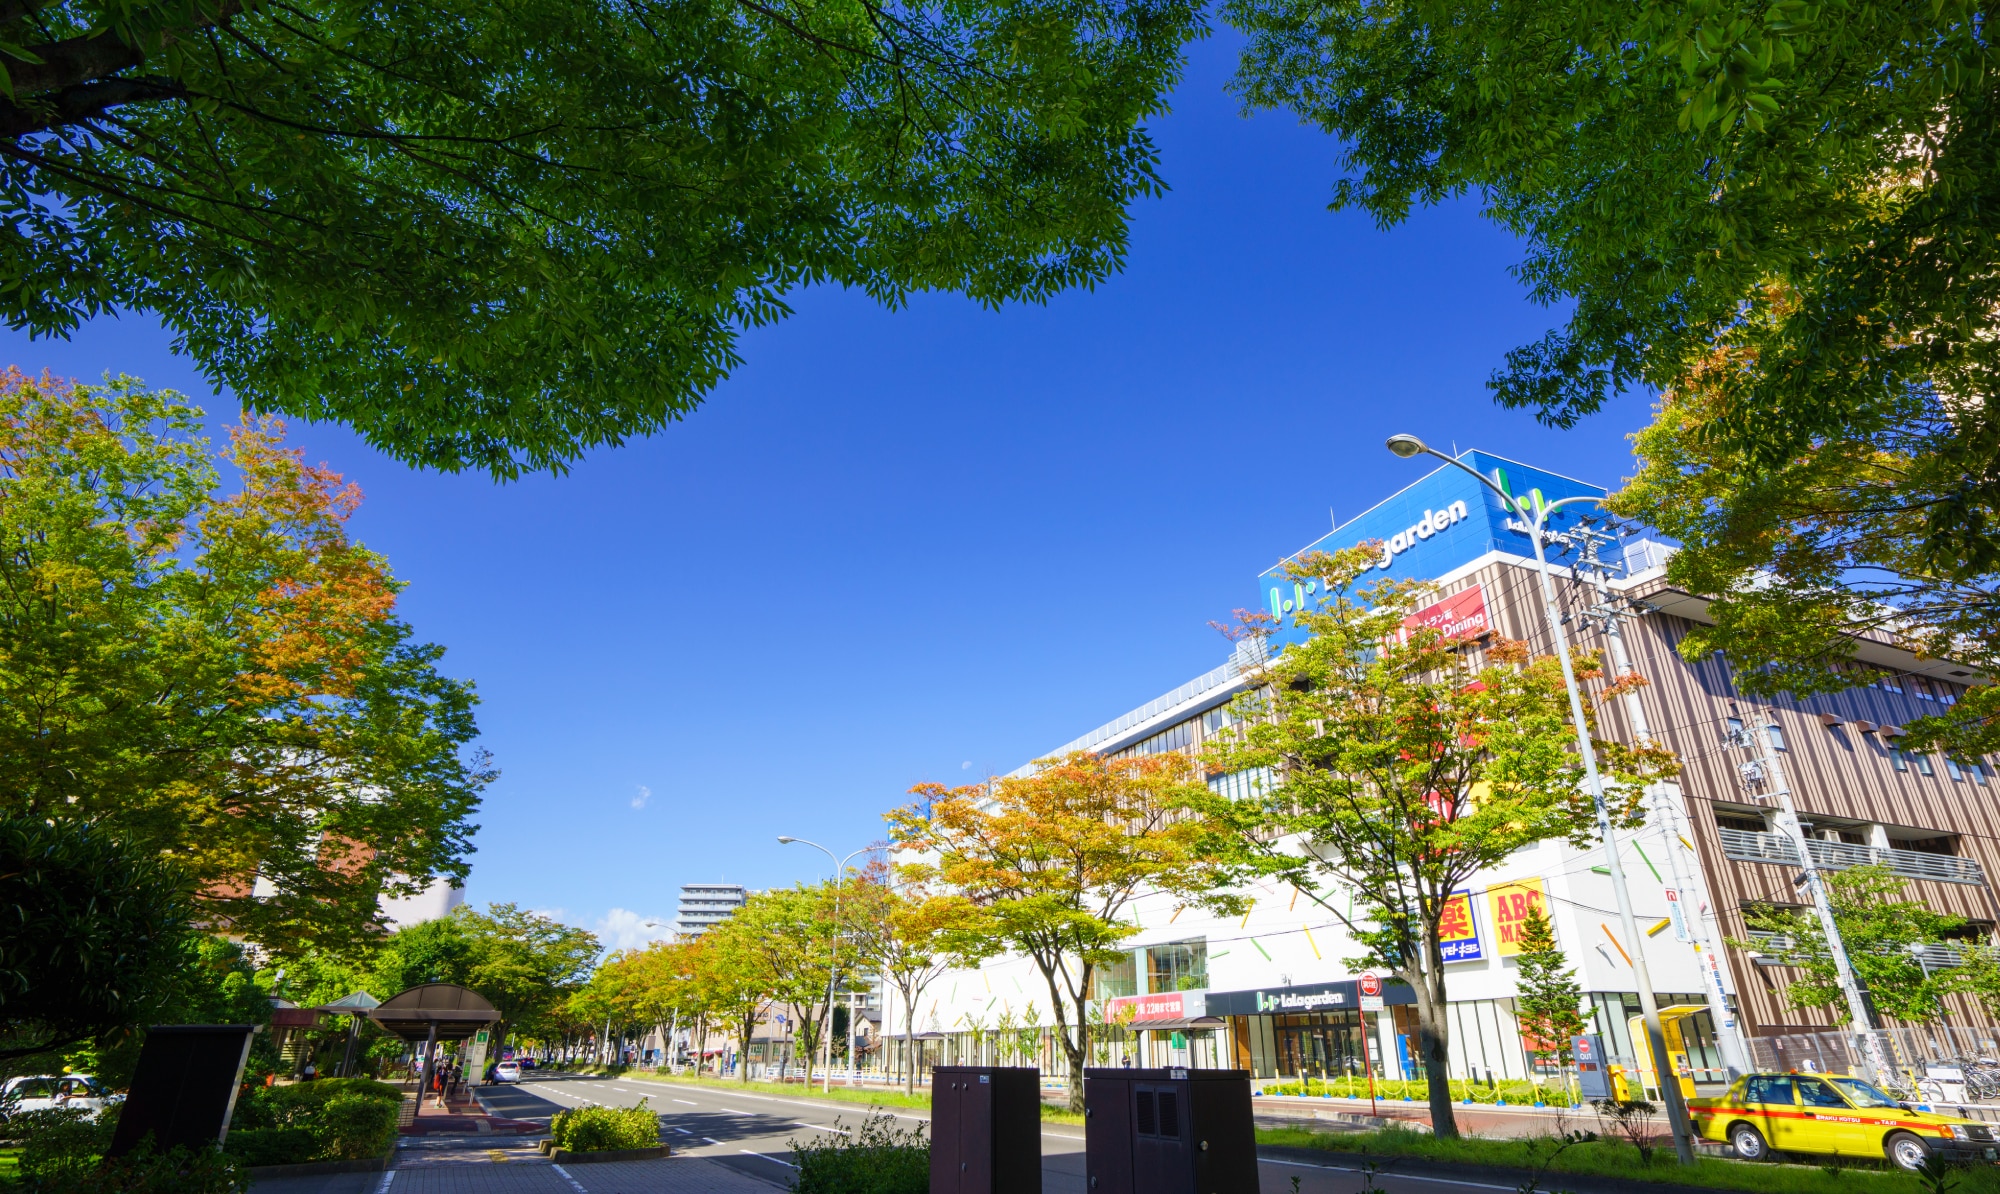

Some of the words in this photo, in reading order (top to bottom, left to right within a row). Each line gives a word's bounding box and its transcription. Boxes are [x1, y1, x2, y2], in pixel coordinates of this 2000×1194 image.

[1442, 613, 1484, 638] Dining
[1438, 897, 1470, 939] 薬
[1498, 889, 1543, 923] ABC
